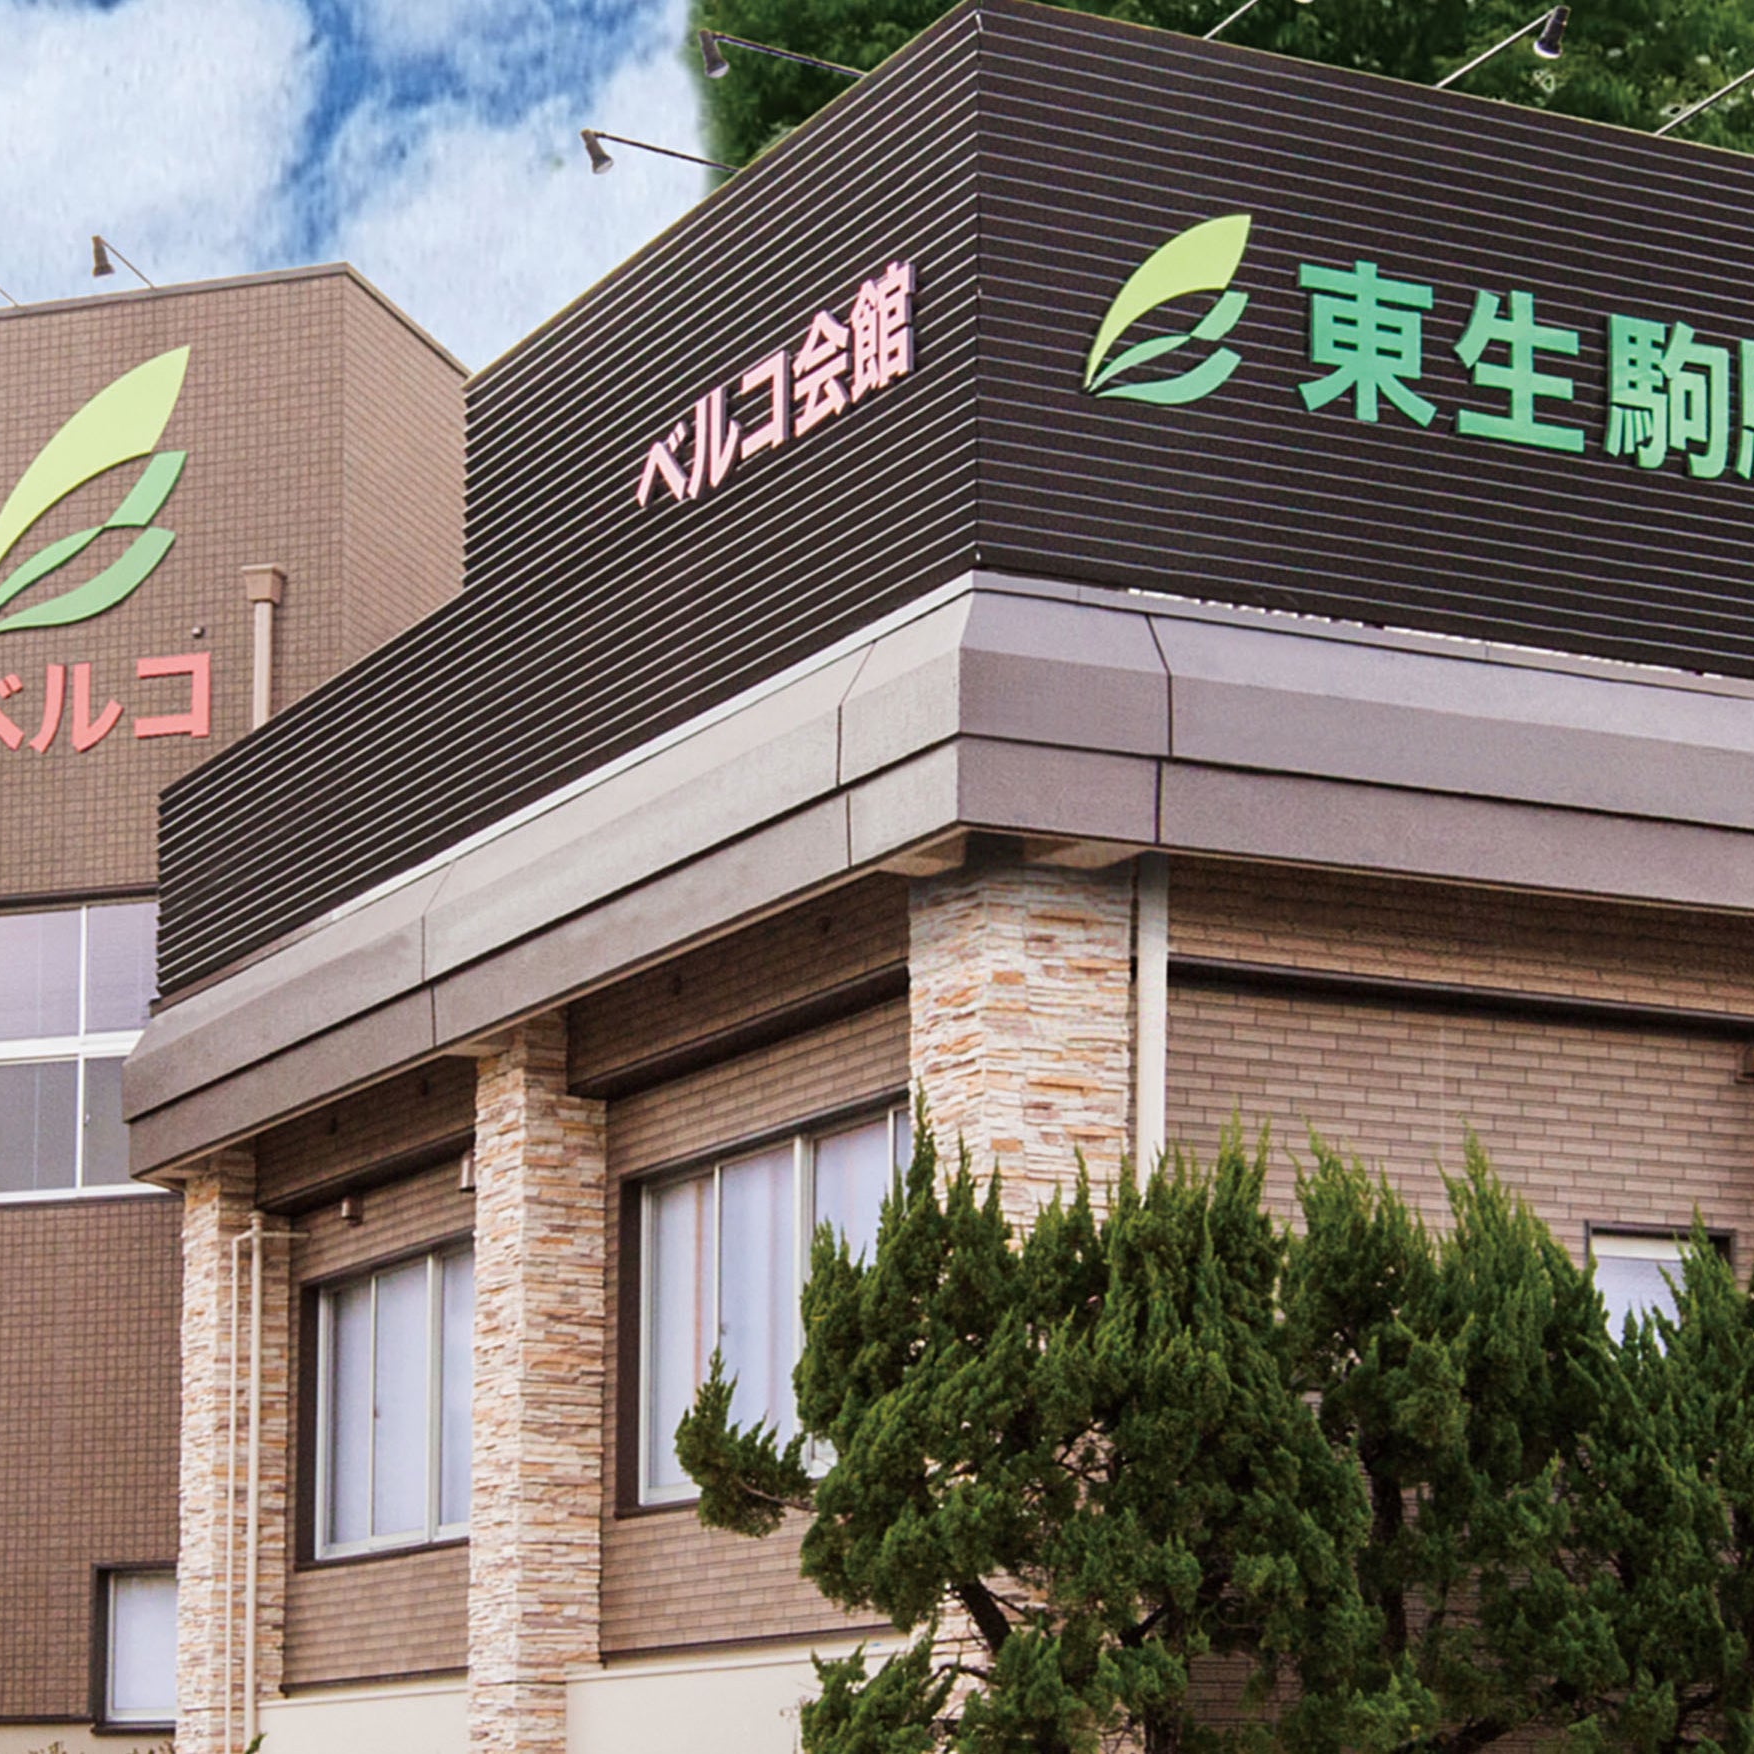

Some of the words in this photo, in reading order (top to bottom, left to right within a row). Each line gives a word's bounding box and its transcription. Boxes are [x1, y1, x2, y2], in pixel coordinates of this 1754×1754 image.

[636, 261, 916, 507] ベルコ会館
